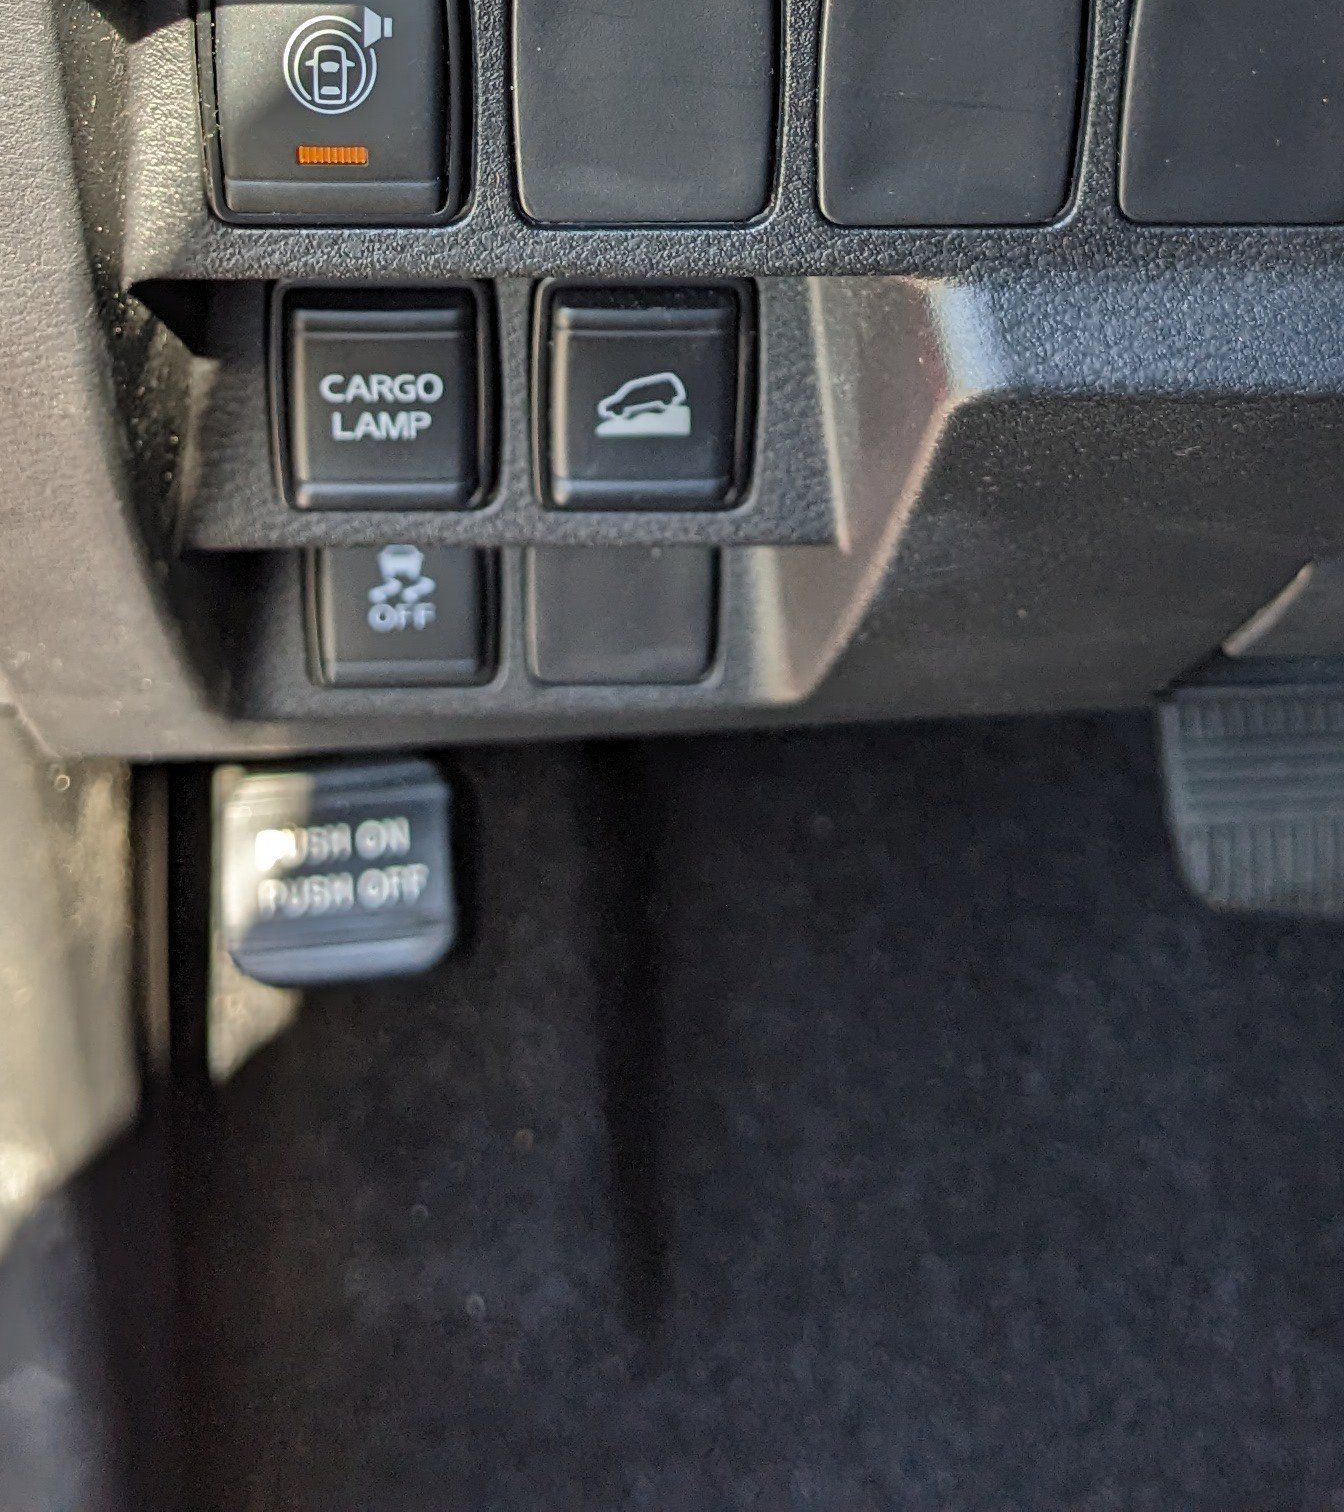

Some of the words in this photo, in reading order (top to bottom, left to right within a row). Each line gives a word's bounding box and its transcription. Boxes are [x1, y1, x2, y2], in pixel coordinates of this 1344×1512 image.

[319, 372, 444, 404] CARGO
[331, 410, 432, 441] LAMP
[368, 602, 436, 632] OFF
[355, 816, 411, 860] ON
[257, 871, 355, 922] PUSH
[357, 863, 430, 909] OFF
